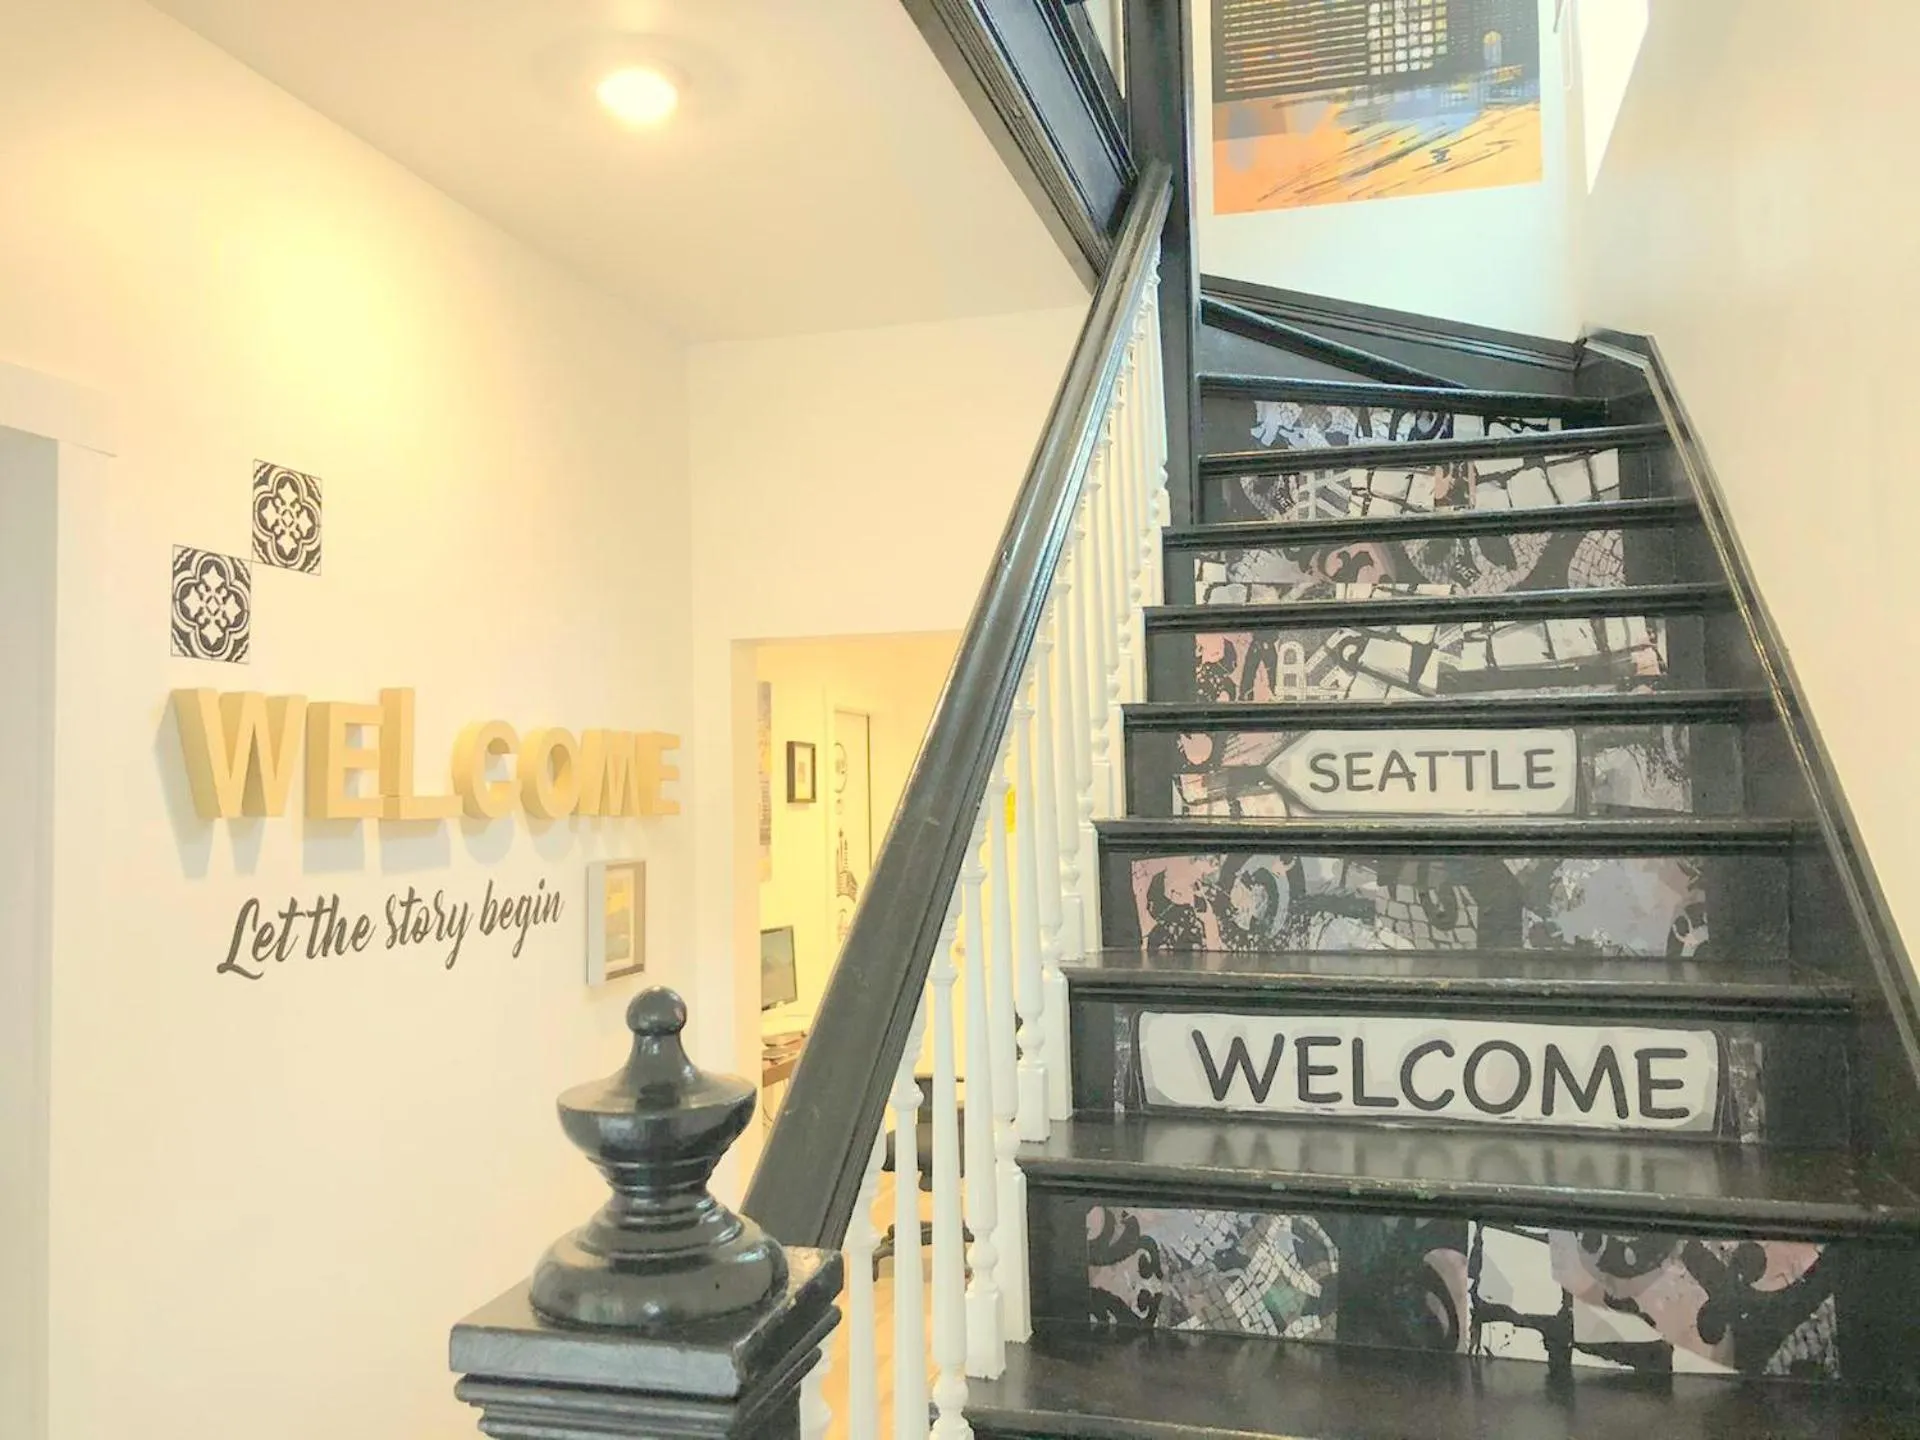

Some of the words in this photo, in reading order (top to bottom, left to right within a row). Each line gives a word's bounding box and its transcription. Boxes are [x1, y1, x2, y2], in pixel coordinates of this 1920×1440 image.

[170, 687, 681, 820] WELCOME
[1308, 747, 1556, 794] SEATTLE
[216, 897, 305, 980] Let
[306, 893, 376, 960] the
[385, 885, 474, 971] story
[479, 878, 564, 959] begin
[1190, 1028, 1690, 1121] WELCOME
